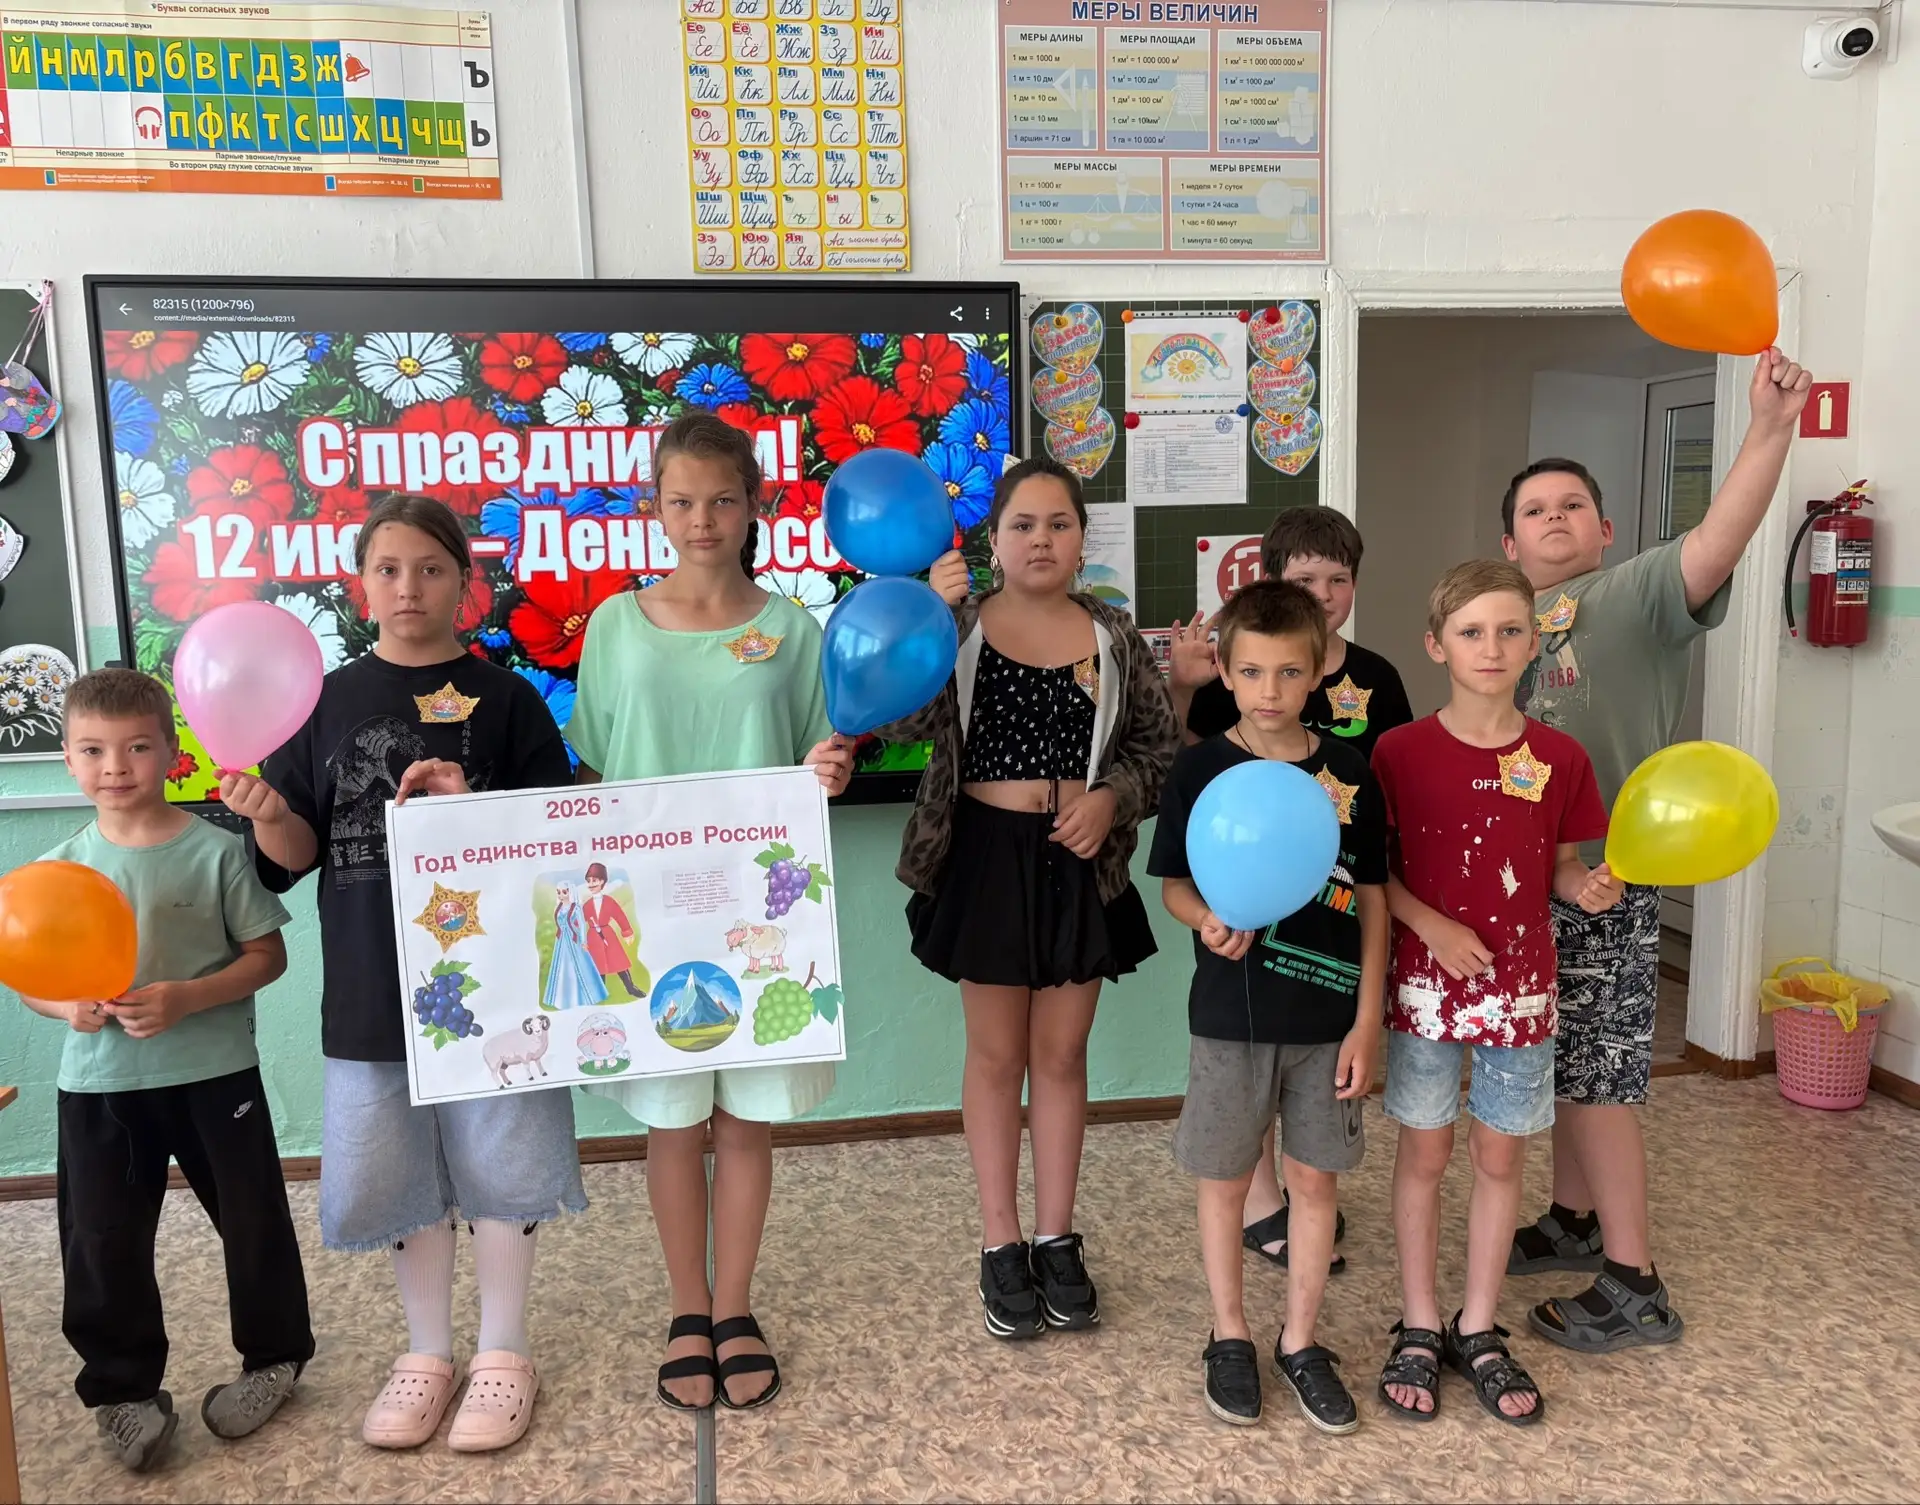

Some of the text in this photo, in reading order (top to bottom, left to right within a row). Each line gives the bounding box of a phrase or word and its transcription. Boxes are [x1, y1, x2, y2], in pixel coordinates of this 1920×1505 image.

[157, 3, 270, 16] Буквы согласных звуков
[1072, 1, 1258, 23] МЕРЫ ВЕЛИЧИН
[687, 21, 883, 37] Ее Ёё Жж Зз Ии
[1020, 33, 1083, 43] МЕРЫ ДЛИНЫ
[1120, 35, 1195, 45] МЕРЫ ПЛОЩАДИ
[1236, 37, 1303, 46] МЕРЫ ОБЪЕМА
[9, 35, 490, 88] й н м л р б в г д з ж ъ
[689, 64, 884, 78] Йй Кк Лл Мм Нн
[691, 108, 883, 121] Оо Пп Рр Сс Тт
[169, 101, 491, 153] п ф к т с ш х ц ч щ ь
[55, 149, 94, 158] Непарные
[215, 152, 301, 163] Парные звонкие/глухие
[692, 150, 888, 162] Уу Фф Хх Цц Чч
[378, 156, 440, 166] Непарные глухие
[1054, 163, 1117, 171] МЕРЫ МАССЫ
[1210, 164, 1237, 172] МЕРЫ
[696, 192, 721, 202] Шш
[740, 192, 766, 203] Щщ
[697, 233, 802, 242] Ээ Юю Яя
[153, 299, 188, 309] 82315
[302, 420, 346, 488] С
[182, 513, 257, 578] 12
[271, 524, 359, 577] ию
[518, 510, 678, 583] День
[1539, 667, 1575, 690] 1968
[1472, 779, 1501, 790] OFF
[546, 797, 601, 820] 2026
[414, 825, 788, 874] Год единства народов России
[1575, 948, 1620, 963] SURFACE
